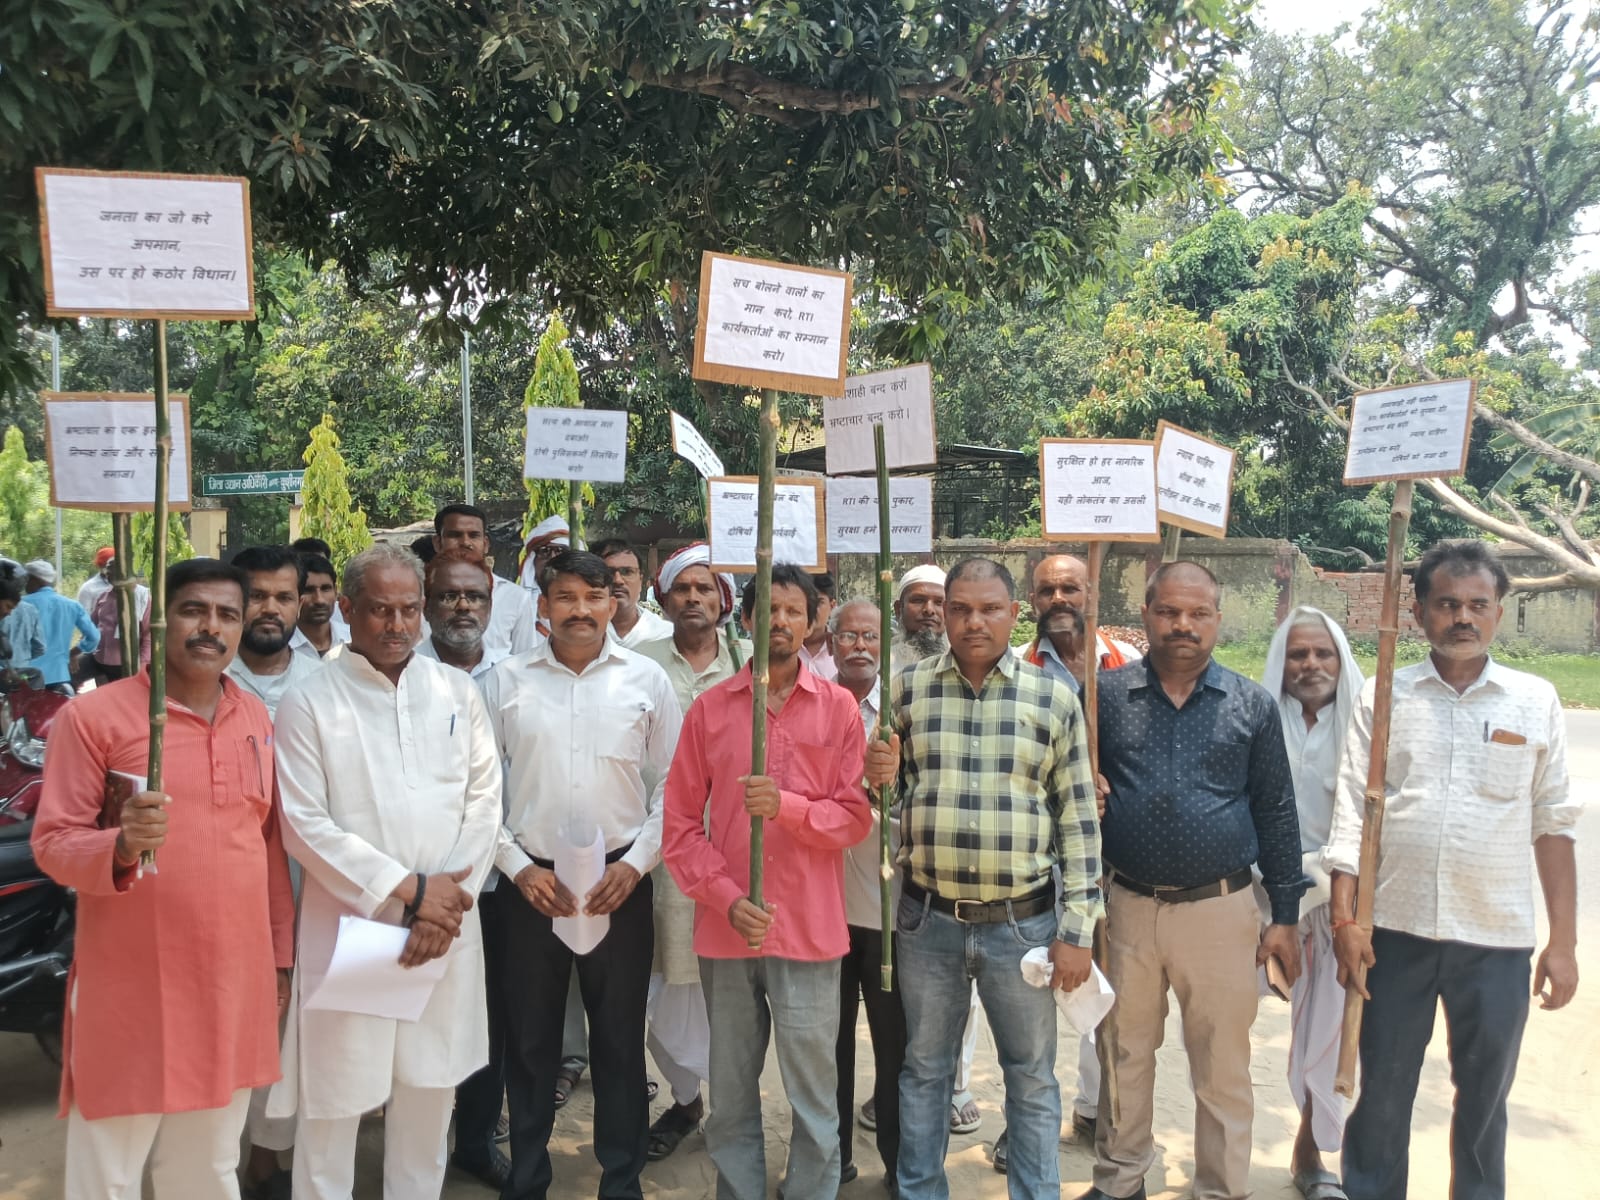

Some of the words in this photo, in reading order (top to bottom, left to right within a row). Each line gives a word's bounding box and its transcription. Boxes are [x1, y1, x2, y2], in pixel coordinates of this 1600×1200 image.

[100, 210, 138, 223] जनता
[144, 211, 162, 224] का
[168, 210, 185, 224] जो
[191, 211, 212, 225] करे
[131, 239, 181, 252] अपमान,
[79, 266, 102, 279] उस
[108, 267, 127, 279] पर
[132, 265, 146, 280] हो
[152, 266, 186, 280] कठोर
[192, 266, 236, 281] विधान।
[732, 277, 751, 288] सच
[755, 280, 782, 294] बोलने
[785, 285, 808, 298] वालों
[811, 290, 825, 301] का
[743, 303, 765, 314] मान
[774, 307, 793, 320] करो,
[798, 311, 815, 322] RTI
[721, 321, 774, 338] कार्यकर्ताओं
[777, 330, 791, 340] का
[794, 332, 829, 345] सम्मान
[762, 349, 785, 361] करो।
[870, 383, 886, 395] बन्द
[121, 426, 140, 435] एक
[124, 447, 145, 457] और
[1057, 455, 1086, 469] सुरक्षित
[1089, 456, 1098, 466] हो
[1101, 458, 1113, 467] हर
[1115, 456, 1145, 467] नागरिक
[103, 470, 135, 479] समाज।
[842, 497, 856, 505] RTI
[858, 495, 870, 505] की
[891, 496, 915, 508] पुकार,
[1057, 494, 1073, 505] यही
[1076, 494, 1106, 504] लोकतंत्र
[1123, 495, 1147, 504] असली
[1094, 515, 1113, 524] राज।
[838, 526, 860, 538] सुरक्षा
[891, 525, 921, 534] सरकार।
